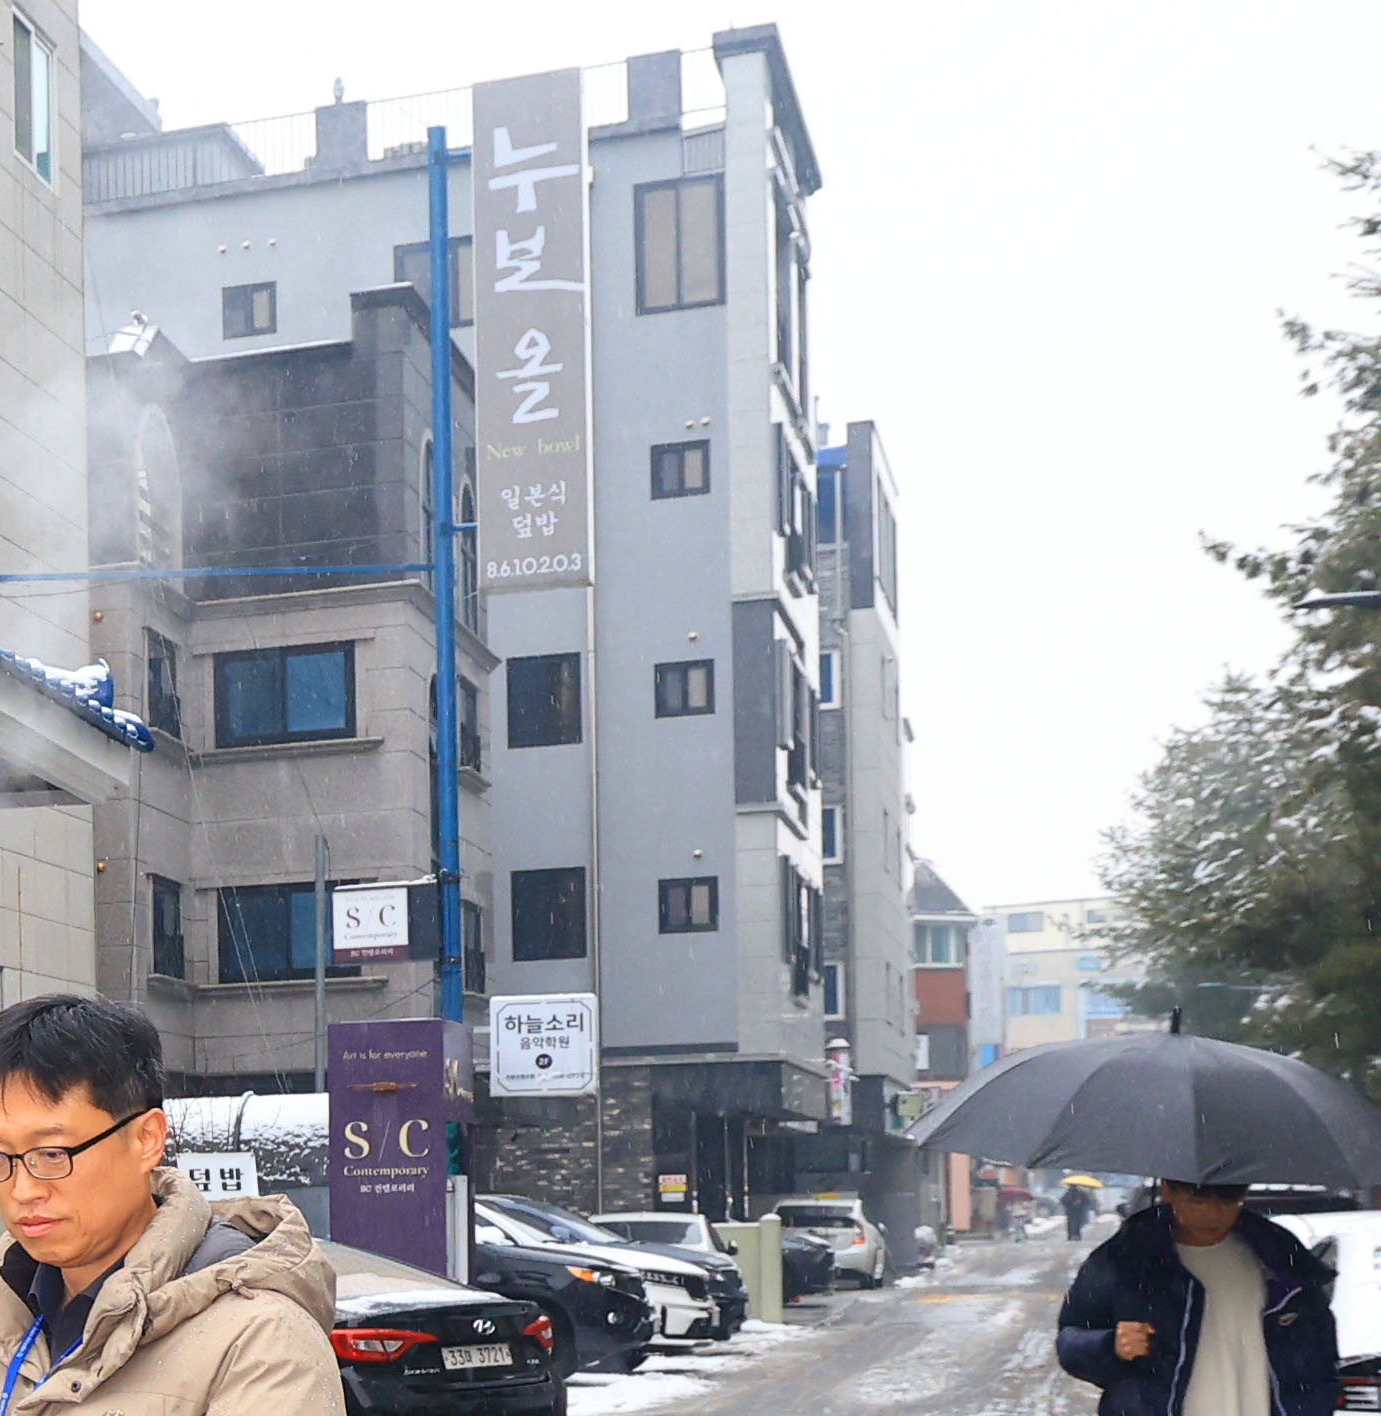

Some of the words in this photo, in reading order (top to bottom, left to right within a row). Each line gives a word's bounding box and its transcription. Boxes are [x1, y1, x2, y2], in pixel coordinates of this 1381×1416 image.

[487, 442, 527, 460] New
[538, 435, 580, 454] bowl
[501, 480, 565, 510] 일본식
[512, 511, 559, 538] 덮밥
[504, 1012, 583, 1034] 하늘소리
[520, 1036, 570, 1050] 음악학원
[343, 1165, 430, 1179] Contemporary
